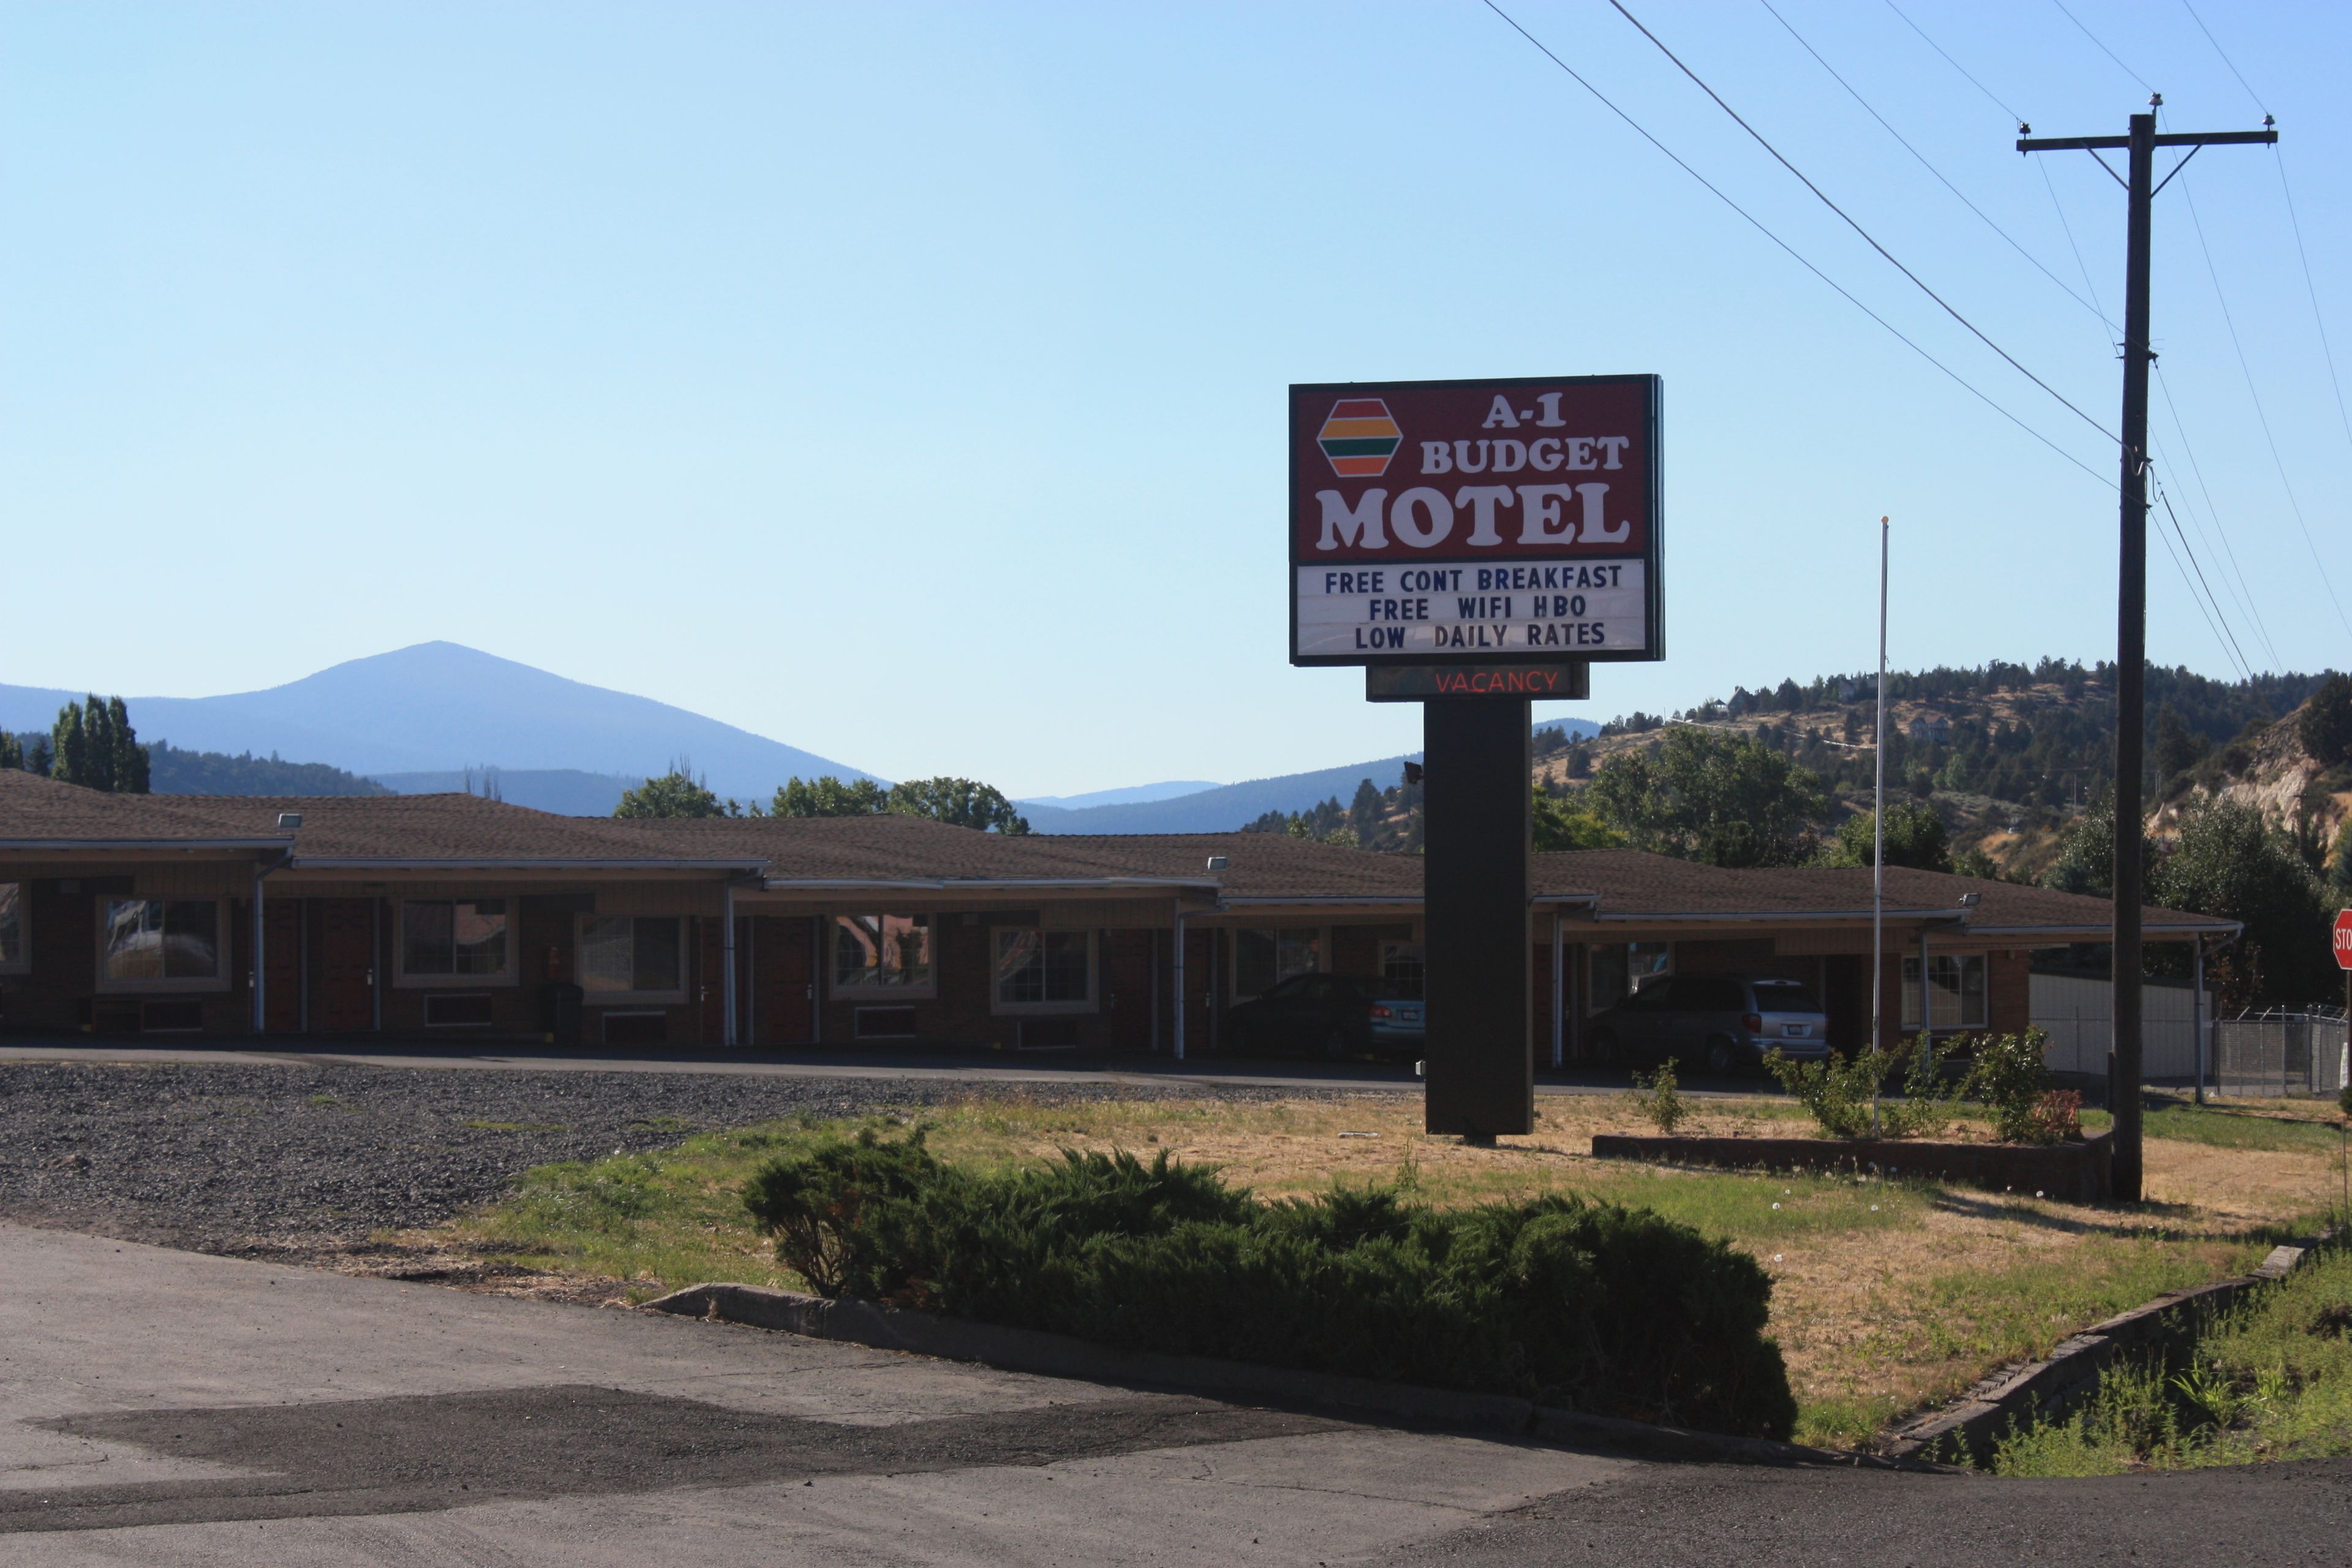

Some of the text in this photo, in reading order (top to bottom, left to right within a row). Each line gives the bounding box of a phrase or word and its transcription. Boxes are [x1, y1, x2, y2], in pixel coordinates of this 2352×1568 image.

[1482, 393, 1566, 428] A-1
[1420, 436, 1629, 474] BUDGET
[1315, 483, 1630, 551] MOTEL
[1325, 565, 1622, 594] FREE CONT BREAKFAST
[1370, 595, 1586, 620] FREE WIFI HBO
[1355, 622, 1605, 649] LOW DAILY RATES
[1435, 671, 1558, 693] VACANCY
